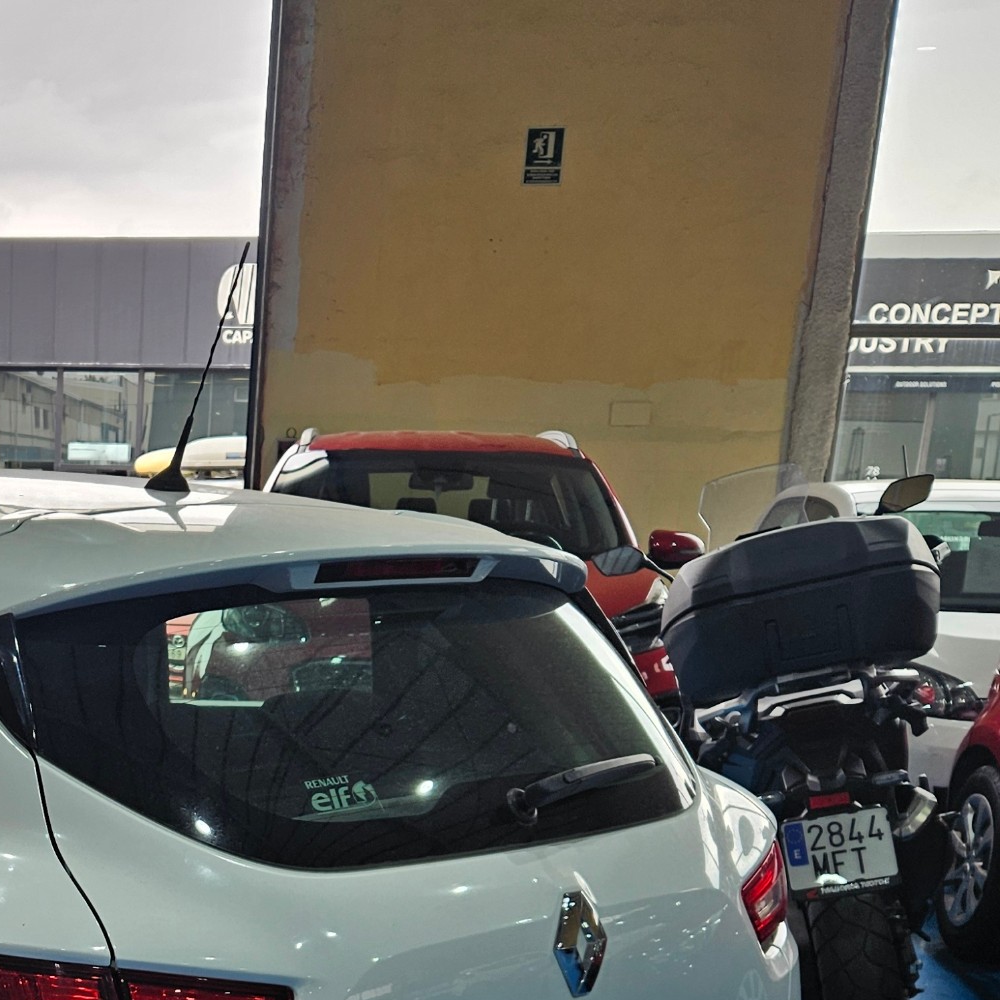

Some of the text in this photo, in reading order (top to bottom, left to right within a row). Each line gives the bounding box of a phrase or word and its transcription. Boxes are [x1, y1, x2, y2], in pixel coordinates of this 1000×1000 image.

[222, 329, 254, 344] CAP
[304, 775, 350, 789] RENAULT
[311, 786, 351, 812] elf
[807, 815, 884, 851] 2844
[811, 846, 867, 879] MFT
